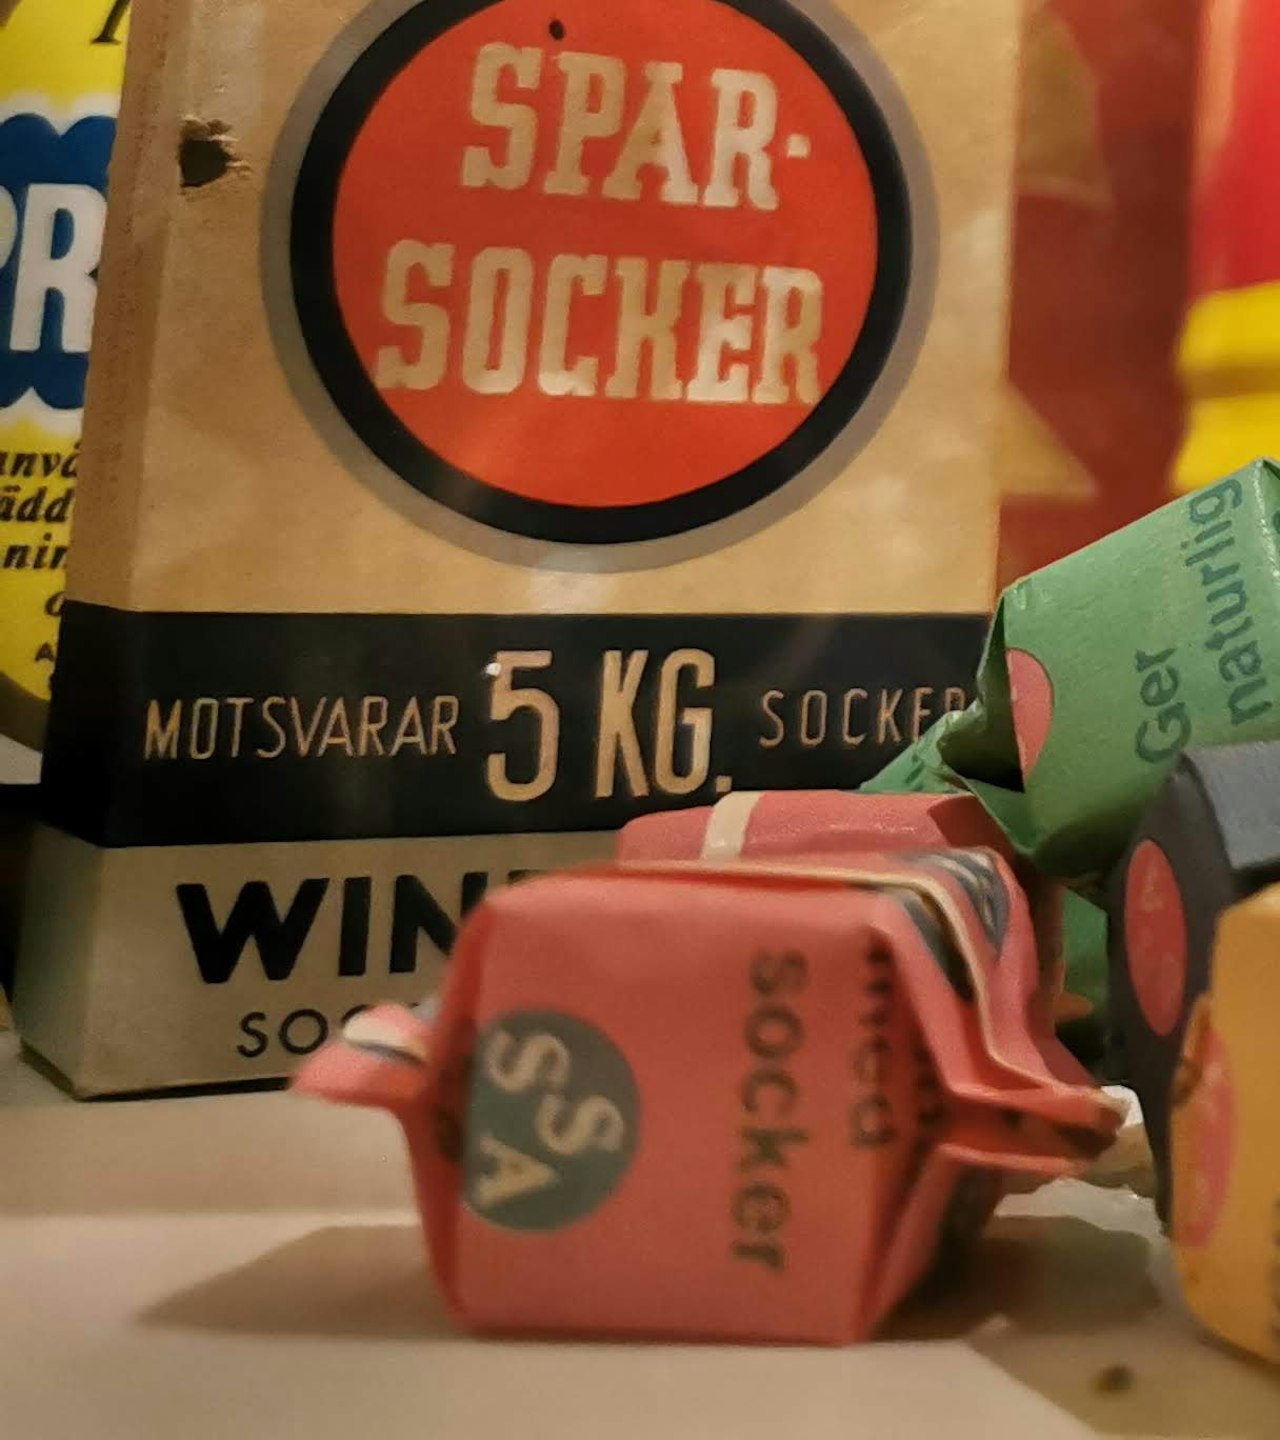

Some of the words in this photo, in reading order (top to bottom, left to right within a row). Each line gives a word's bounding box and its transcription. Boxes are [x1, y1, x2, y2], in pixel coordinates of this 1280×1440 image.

[461, 42, 811, 211] SPAR-
[376, 238, 824, 406] SOCKER
[1178, 477, 1274, 727] naturlig
[143, 693, 461, 761] MOTSVARAR
[486, 647, 561, 803] 5
[597, 647, 732, 799] KG.
[1133, 647, 1193, 764] Ger
[729, 948, 811, 1279] socker
